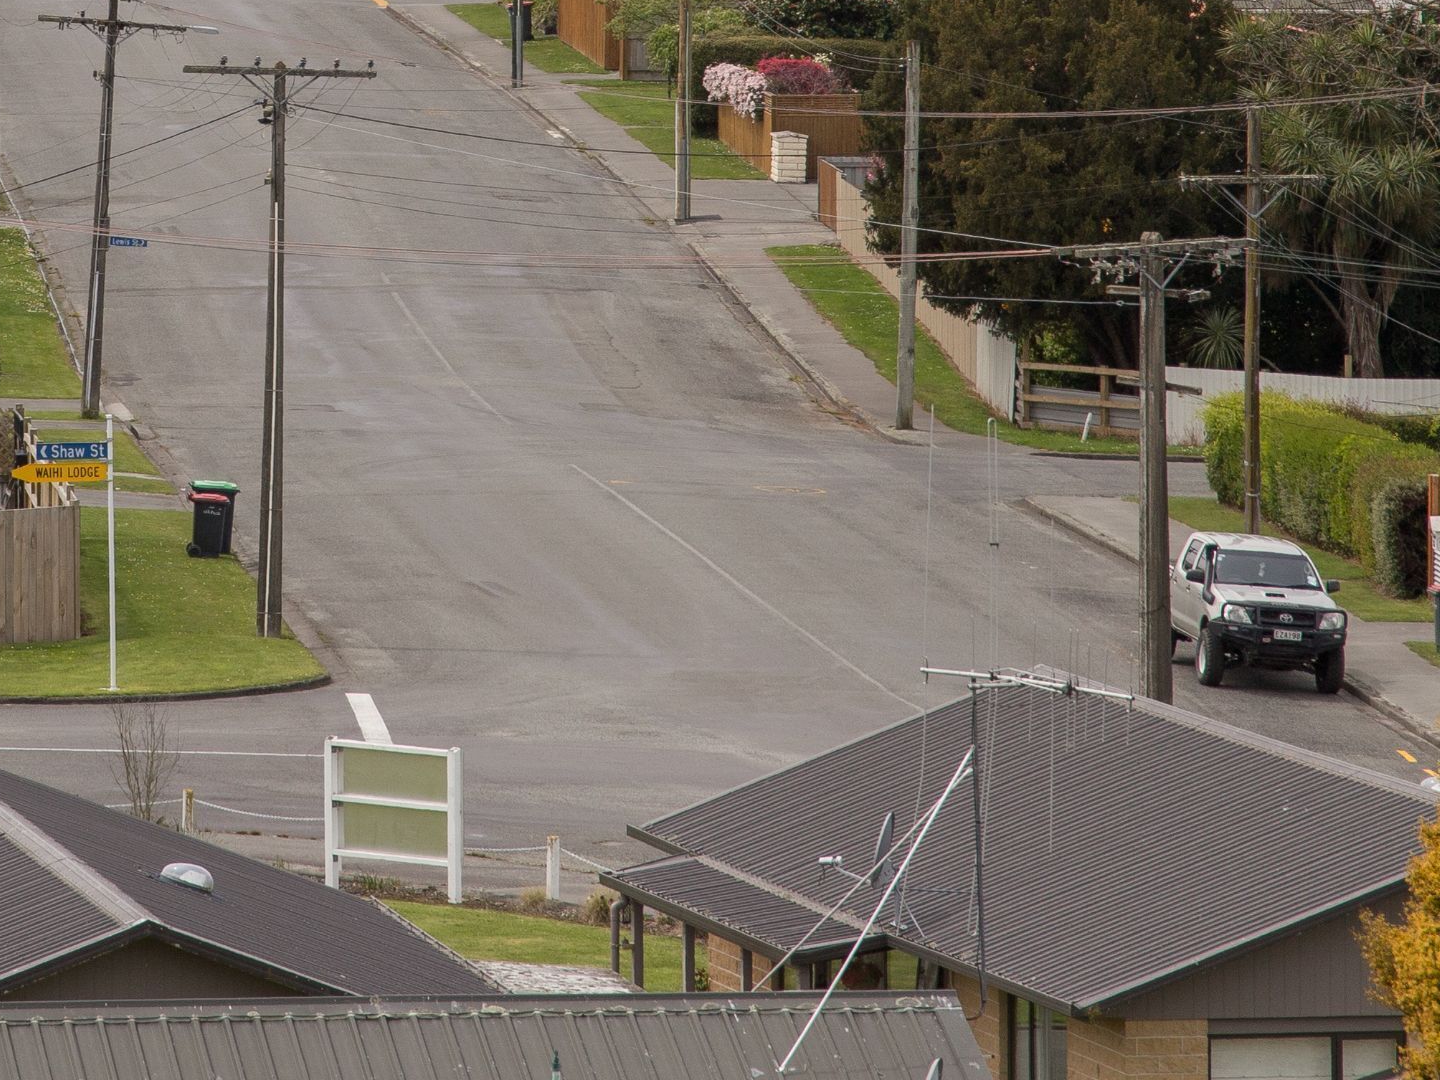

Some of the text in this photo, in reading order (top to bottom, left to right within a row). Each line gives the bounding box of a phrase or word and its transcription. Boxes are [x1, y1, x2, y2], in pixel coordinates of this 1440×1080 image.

[112, 237, 131, 245] Lewis
[51, 444, 104, 458] Shaw St
[35, 466, 100, 478] WAIHI LODGE
